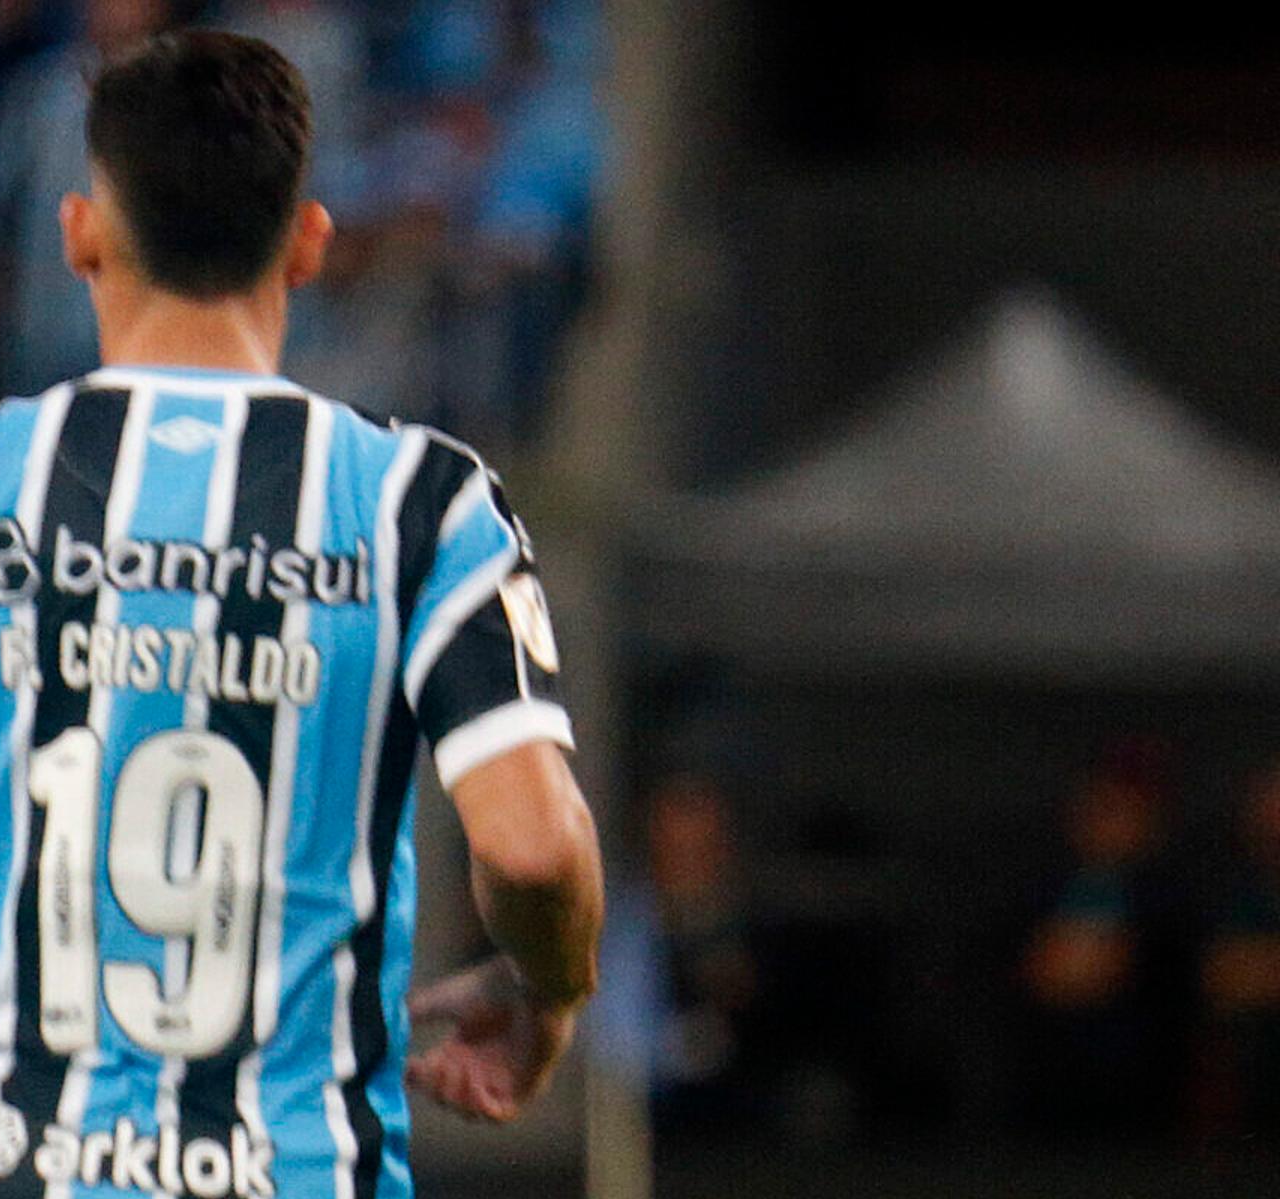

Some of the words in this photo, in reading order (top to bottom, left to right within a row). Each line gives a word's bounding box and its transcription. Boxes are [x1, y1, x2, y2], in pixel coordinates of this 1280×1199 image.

[54, 522, 372, 607] banrisul
[59, 620, 322, 706] CRISTALDO
[29, 726, 266, 1060] 19
[35, 1115, 276, 1199] arklok
